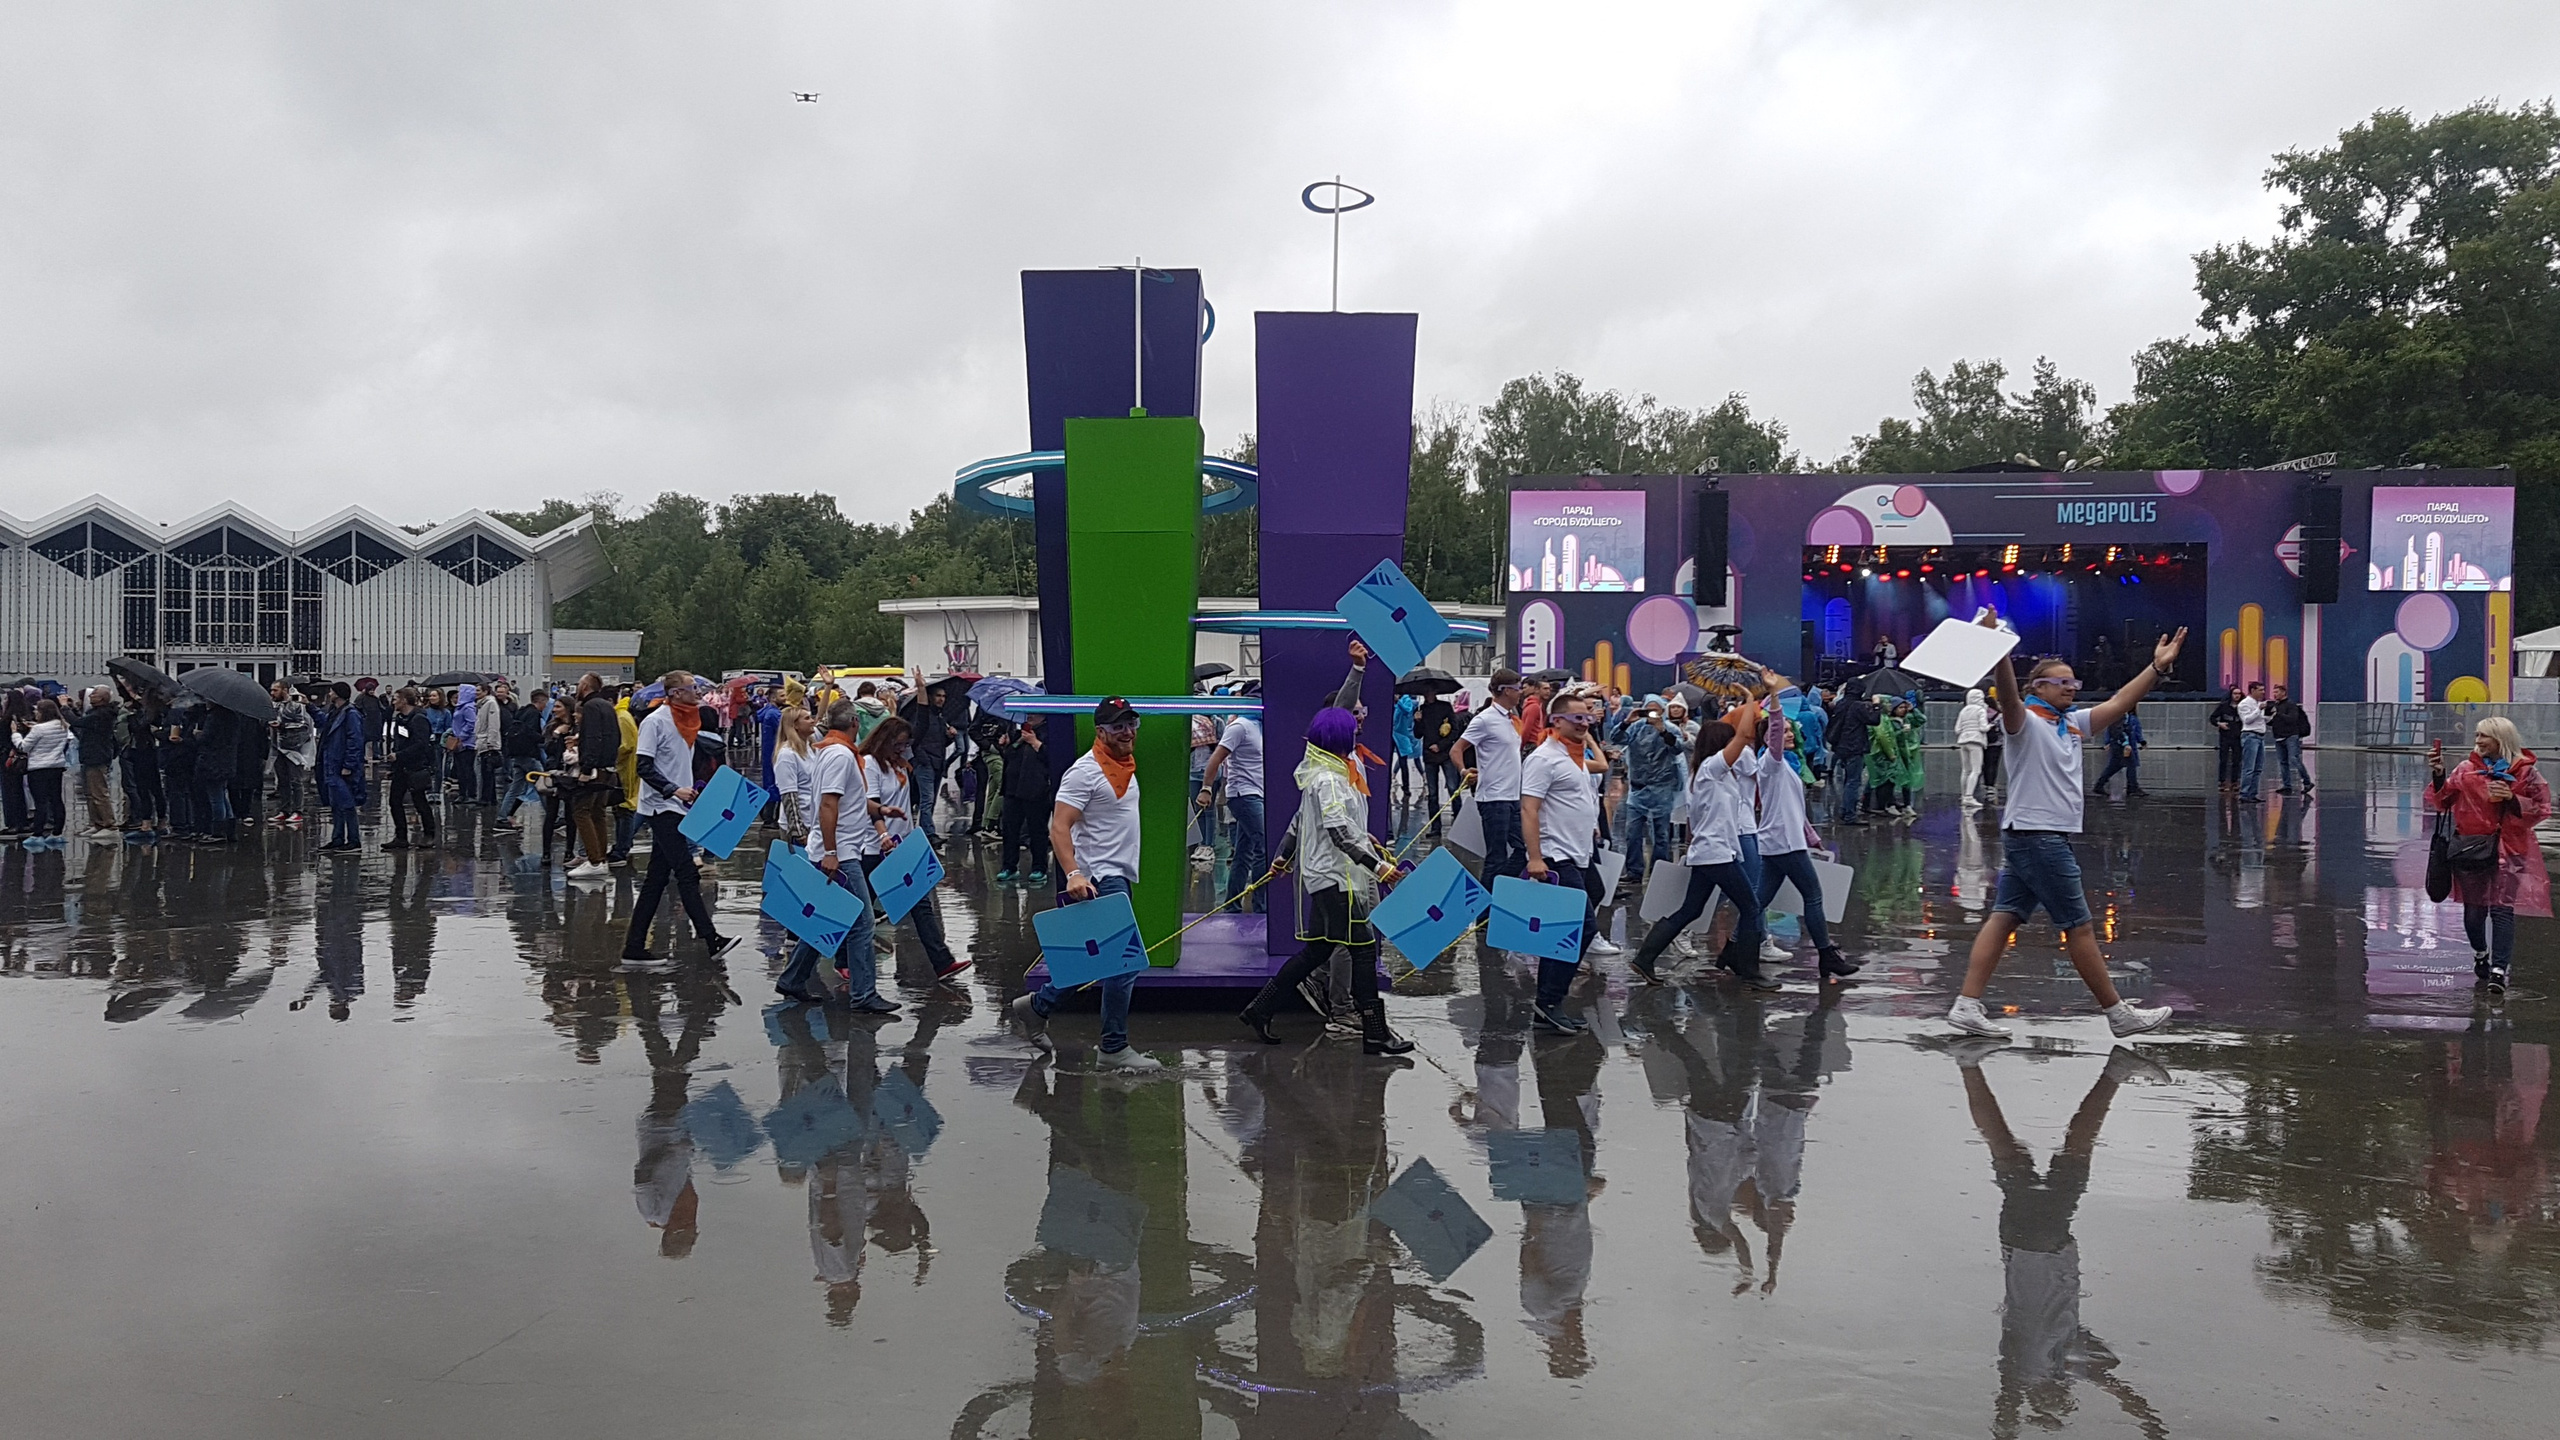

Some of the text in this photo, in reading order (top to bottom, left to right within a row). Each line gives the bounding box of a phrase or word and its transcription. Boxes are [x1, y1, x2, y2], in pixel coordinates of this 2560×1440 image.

[1562, 506, 1593, 516] ПАРАД
[2426, 502, 2459, 512] ПАРАД
[1533, 517, 1622, 527] «ГОРОД БУДУЩЕГО»
[2396, 514, 2489, 524] «ГОРОД БУДУЩЕГО»
